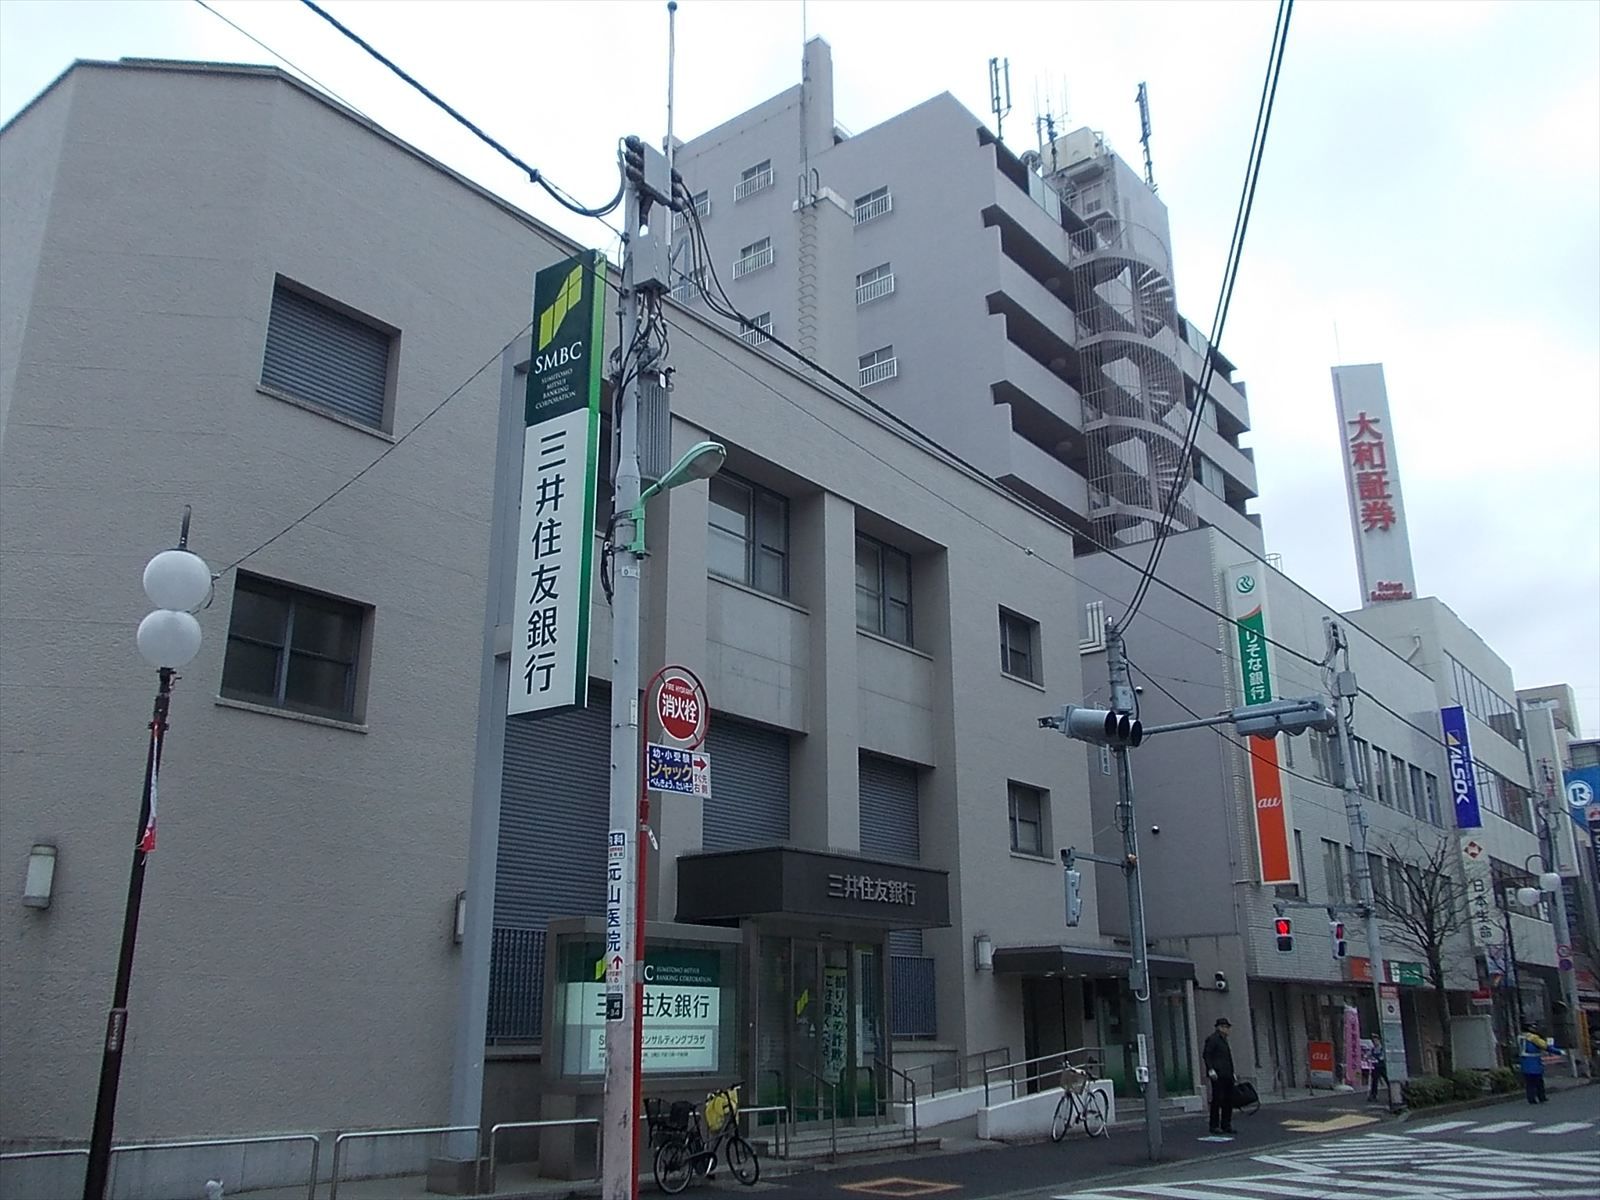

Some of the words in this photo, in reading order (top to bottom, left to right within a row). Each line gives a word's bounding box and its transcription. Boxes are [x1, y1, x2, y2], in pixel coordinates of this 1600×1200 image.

[535, 341, 582, 374] SMBC
[535, 391, 576, 409] CORPORATION
[543, 385, 570, 399] BANKING
[1348, 411, 1397, 533] 大和証券
[524, 430, 567, 696] 三井住友銀行
[1245, 628, 1265, 701] りそな銀行
[662, 692, 698, 724] 消火栓
[650, 759, 692, 782] ジャック
[1450, 746, 1469, 805] ALSOK
[1258, 797, 1282, 809] au
[829, 874, 917, 905] 三井住友銀行
[1472, 879, 1492, 938] 日本生命
[596, 992, 710, 1019] 三住友銀行
[1312, 1052, 1329, 1061] au
